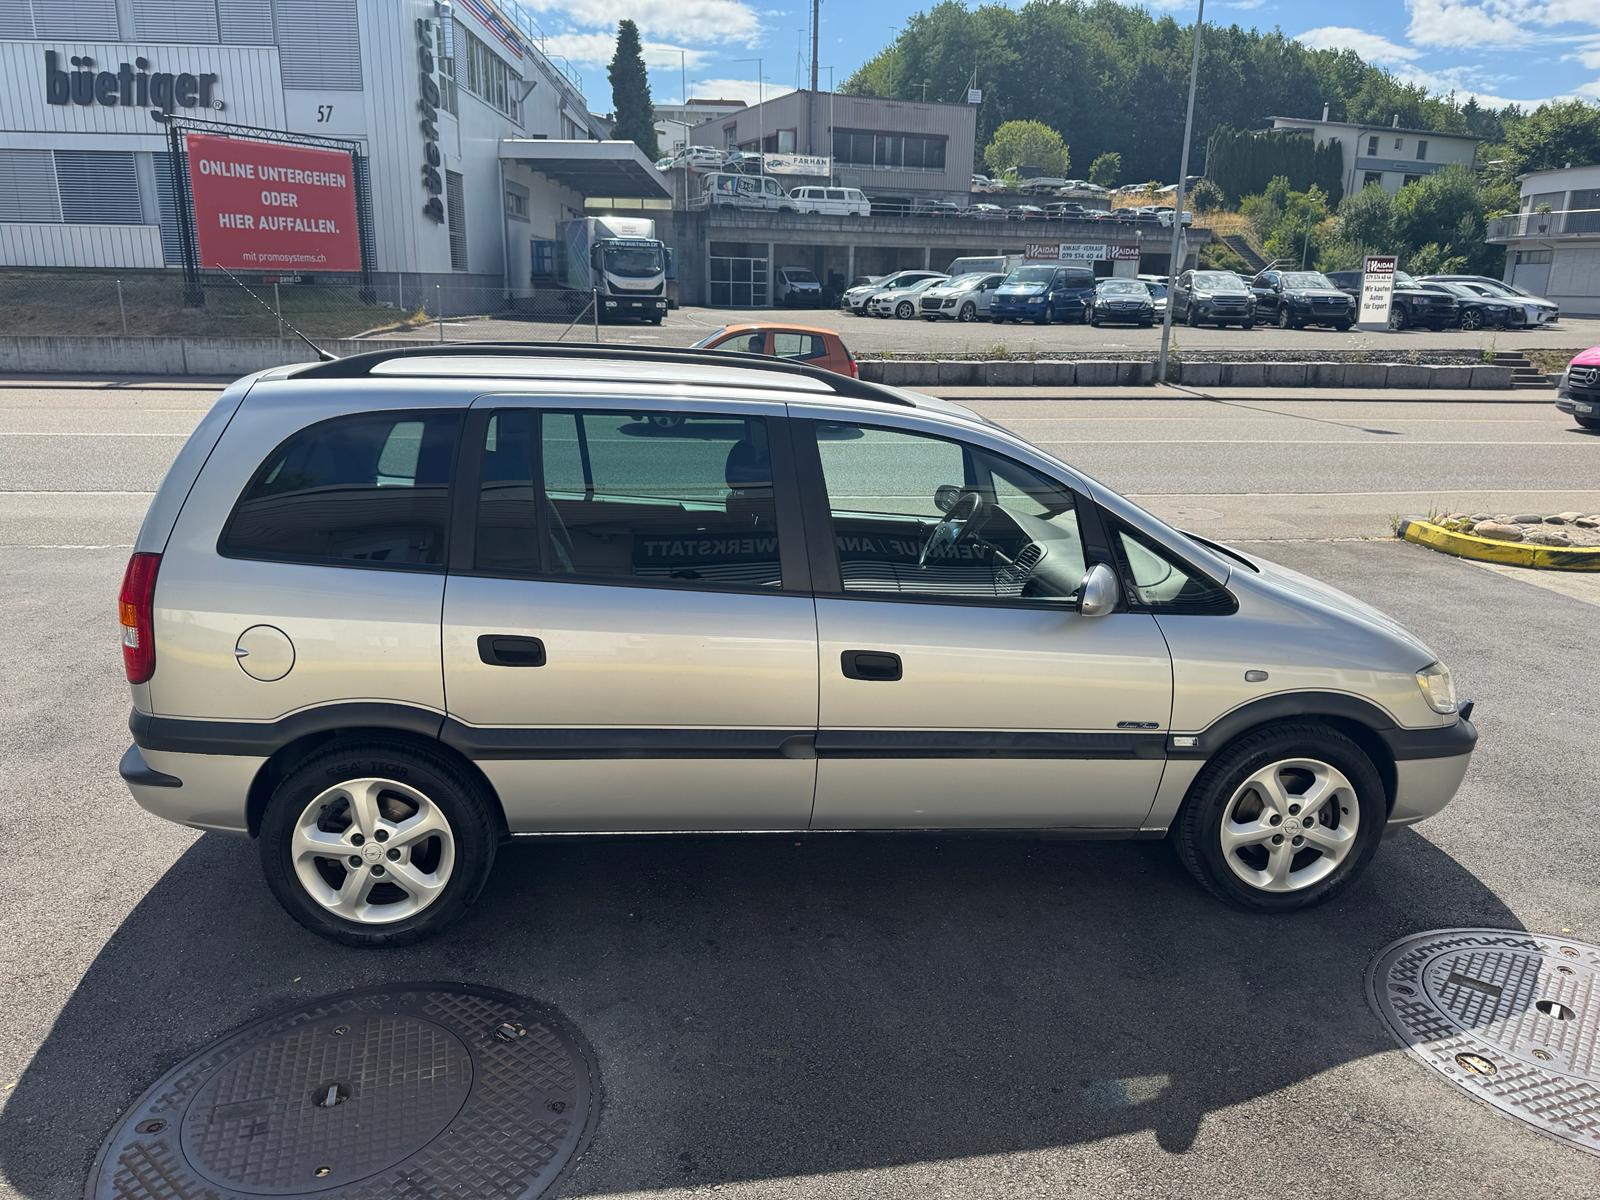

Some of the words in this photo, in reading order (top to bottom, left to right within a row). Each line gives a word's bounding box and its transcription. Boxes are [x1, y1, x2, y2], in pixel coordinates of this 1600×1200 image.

[45, 50, 219, 123] büetiger
[317, 105, 333, 123] 57
[793, 157, 827, 165] FARHAN
[199, 159, 255, 179] ONLINE
[258, 166, 346, 188] UNTERGEHEN
[261, 191, 298, 207] ODER
[218, 213, 255, 230] HIER
[259, 216, 340, 234] AUFFALLEN.
[242, 252, 256, 261] mit
[259, 253, 327, 264] promosystems.ch
[1372, 303, 1387, 311] Export
